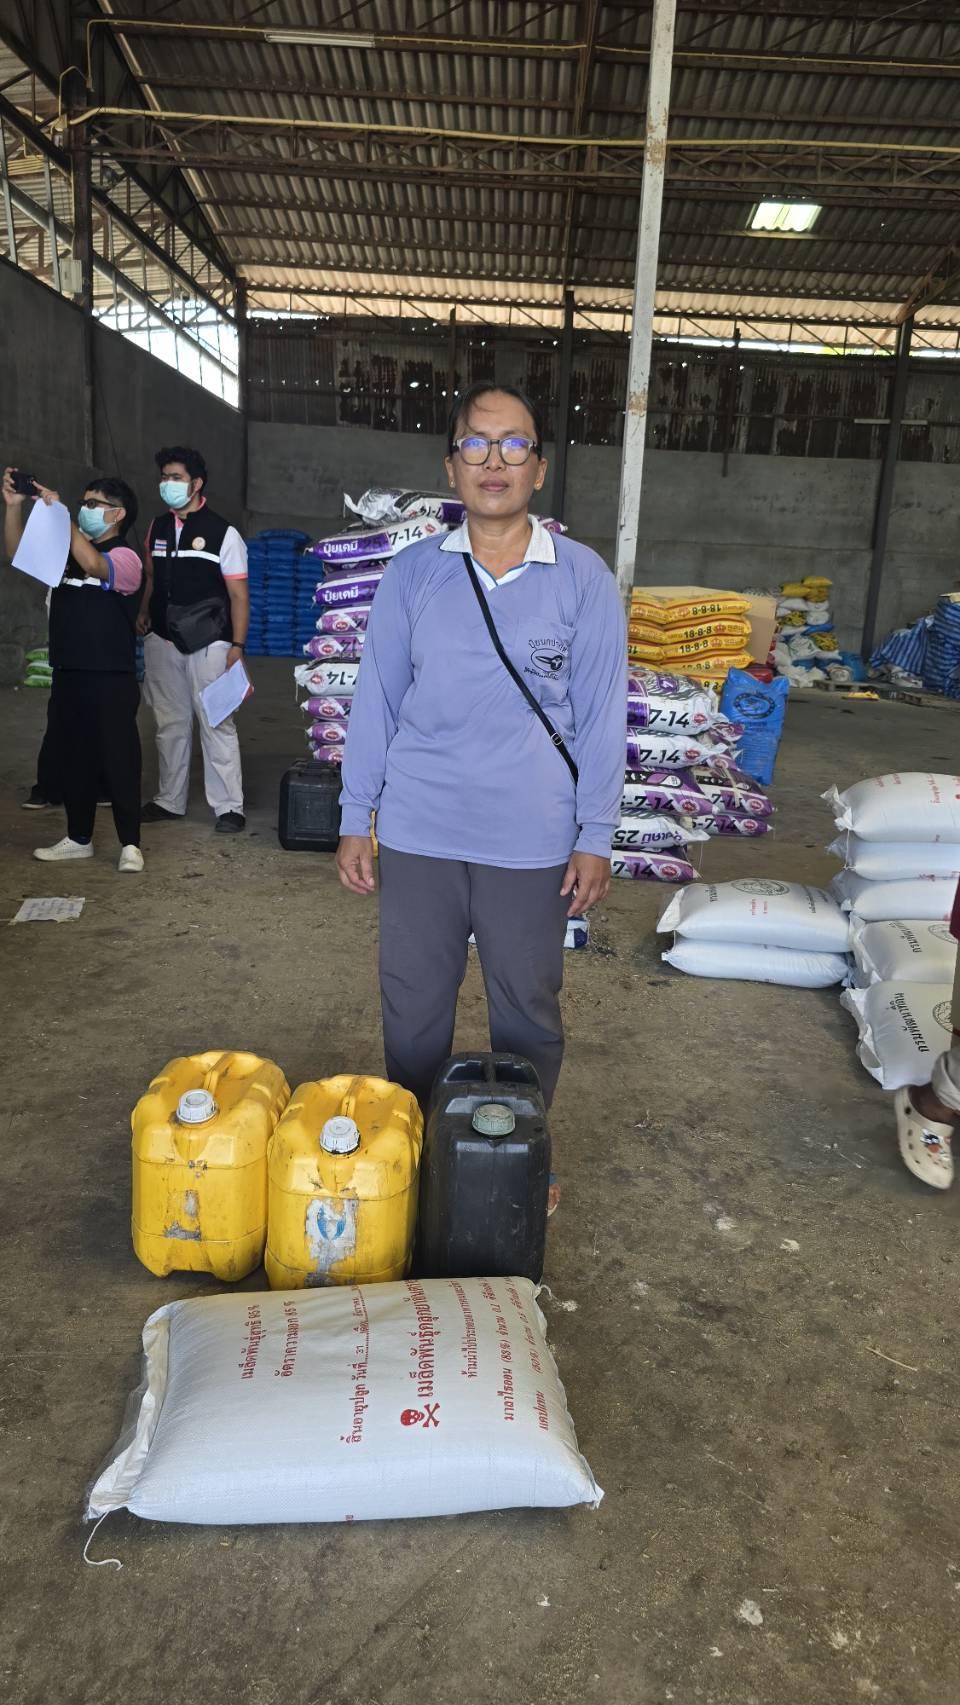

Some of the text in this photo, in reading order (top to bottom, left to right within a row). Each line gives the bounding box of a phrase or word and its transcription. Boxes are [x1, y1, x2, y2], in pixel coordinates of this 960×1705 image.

[323, 540, 358, 557] ปุ๋ยเคมี
[323, 585, 359, 604] ปุ๋ยเคมี
[683, 626, 712, 639] 18-8-8
[678, 640, 709, 654] 18-8-8
[274, 1317, 299, 1377] อัตราความงอก
[340, 1383, 370, 1443] สิ้นอายุปลูก
